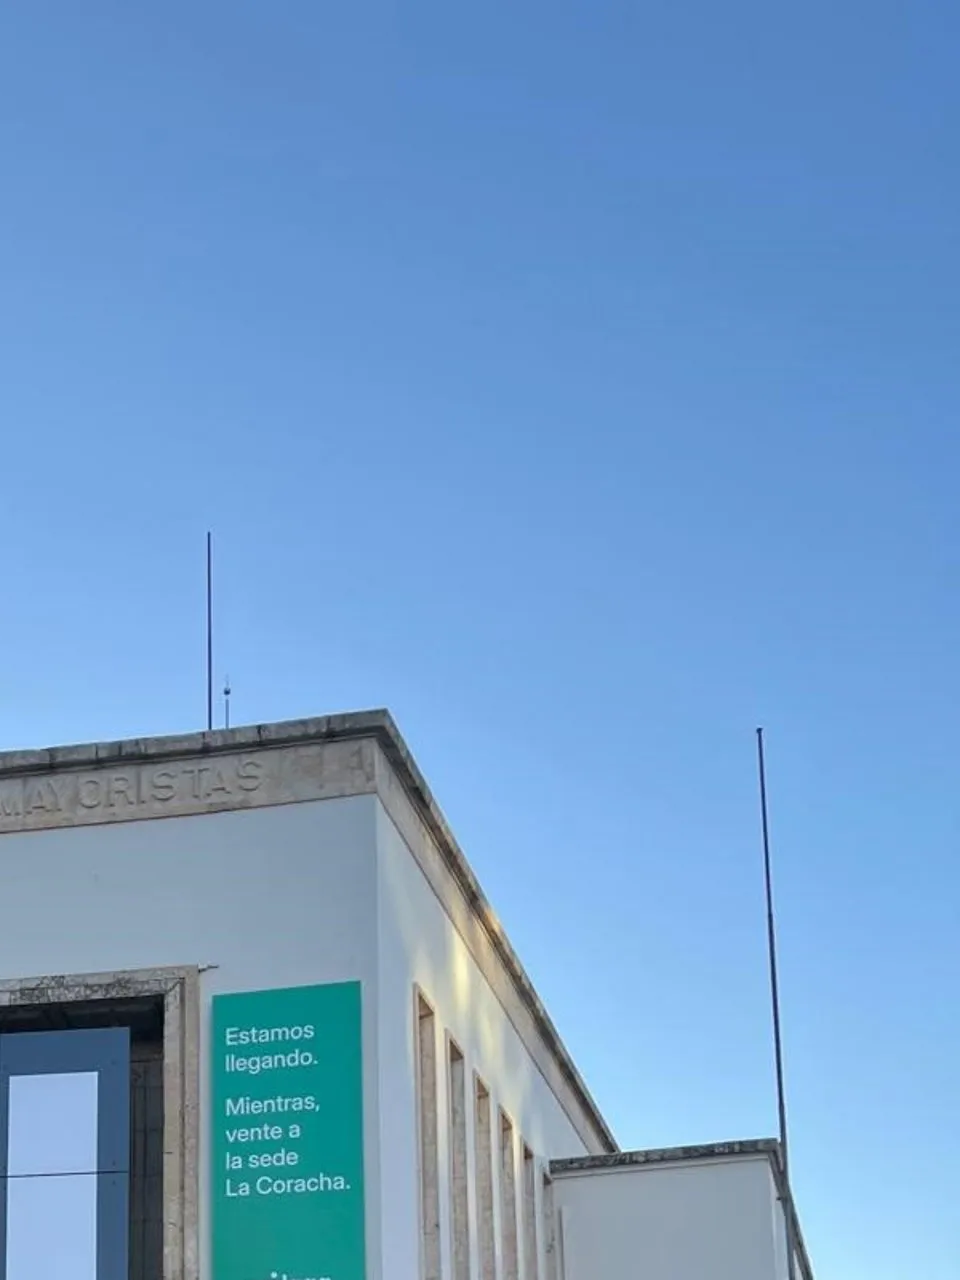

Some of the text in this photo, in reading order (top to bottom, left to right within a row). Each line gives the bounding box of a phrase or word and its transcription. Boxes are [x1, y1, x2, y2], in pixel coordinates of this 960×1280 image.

[225, 1024, 315, 1046] Estamos
[225, 1049, 319, 1075] llegando.
[225, 1095, 320, 1117] Mientras,
[225, 1123, 301, 1143] vente a
[225, 1148, 299, 1170] la sede
[225, 1172, 351, 1197] La Coracha.
